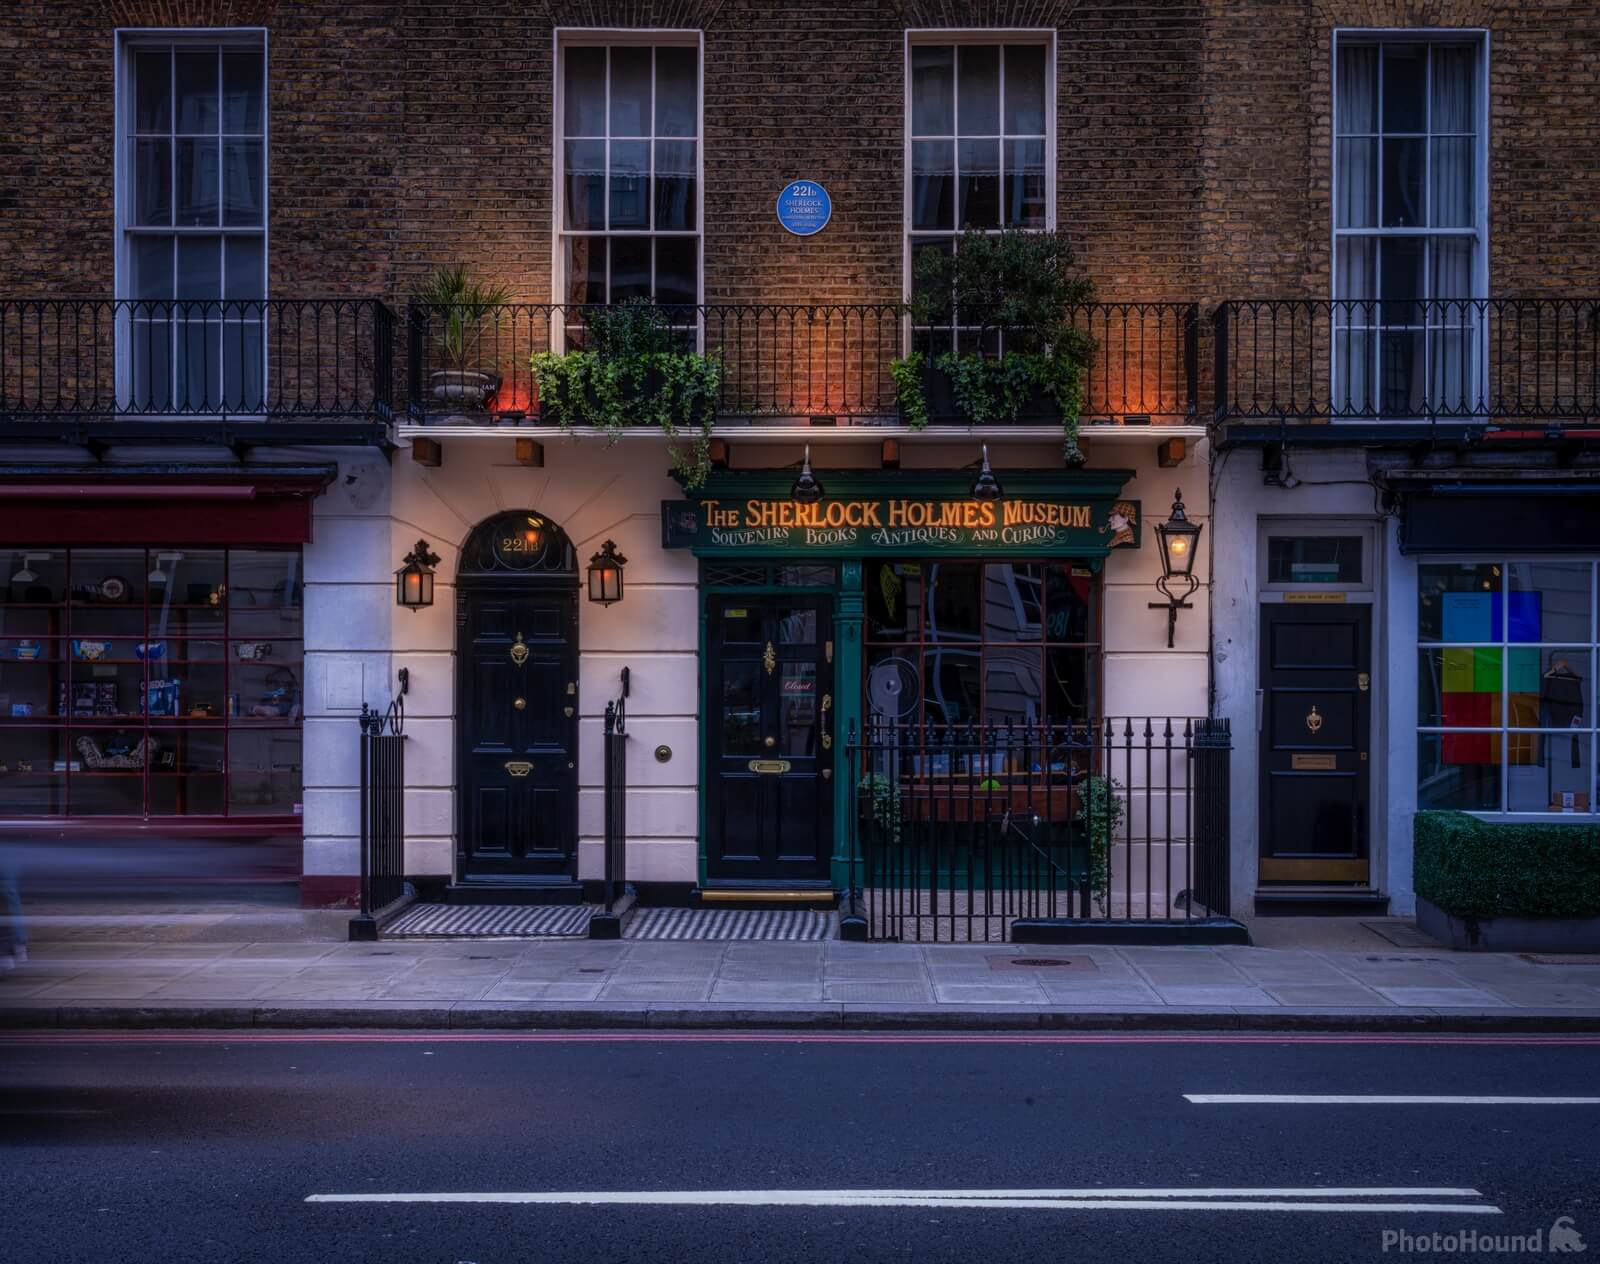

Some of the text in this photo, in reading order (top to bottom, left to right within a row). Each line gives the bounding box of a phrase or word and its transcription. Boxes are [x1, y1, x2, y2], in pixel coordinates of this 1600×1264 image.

[784, 199, 824, 207] SHERLOCK
[745, 498, 882, 529] SHERLOCK
[888, 499, 997, 529] HOLMES
[1002, 499, 1092, 529] MUSEUM
[711, 525, 1057, 546] SOUVENIRS BOOKS ANTIQUES AND CURIOS
